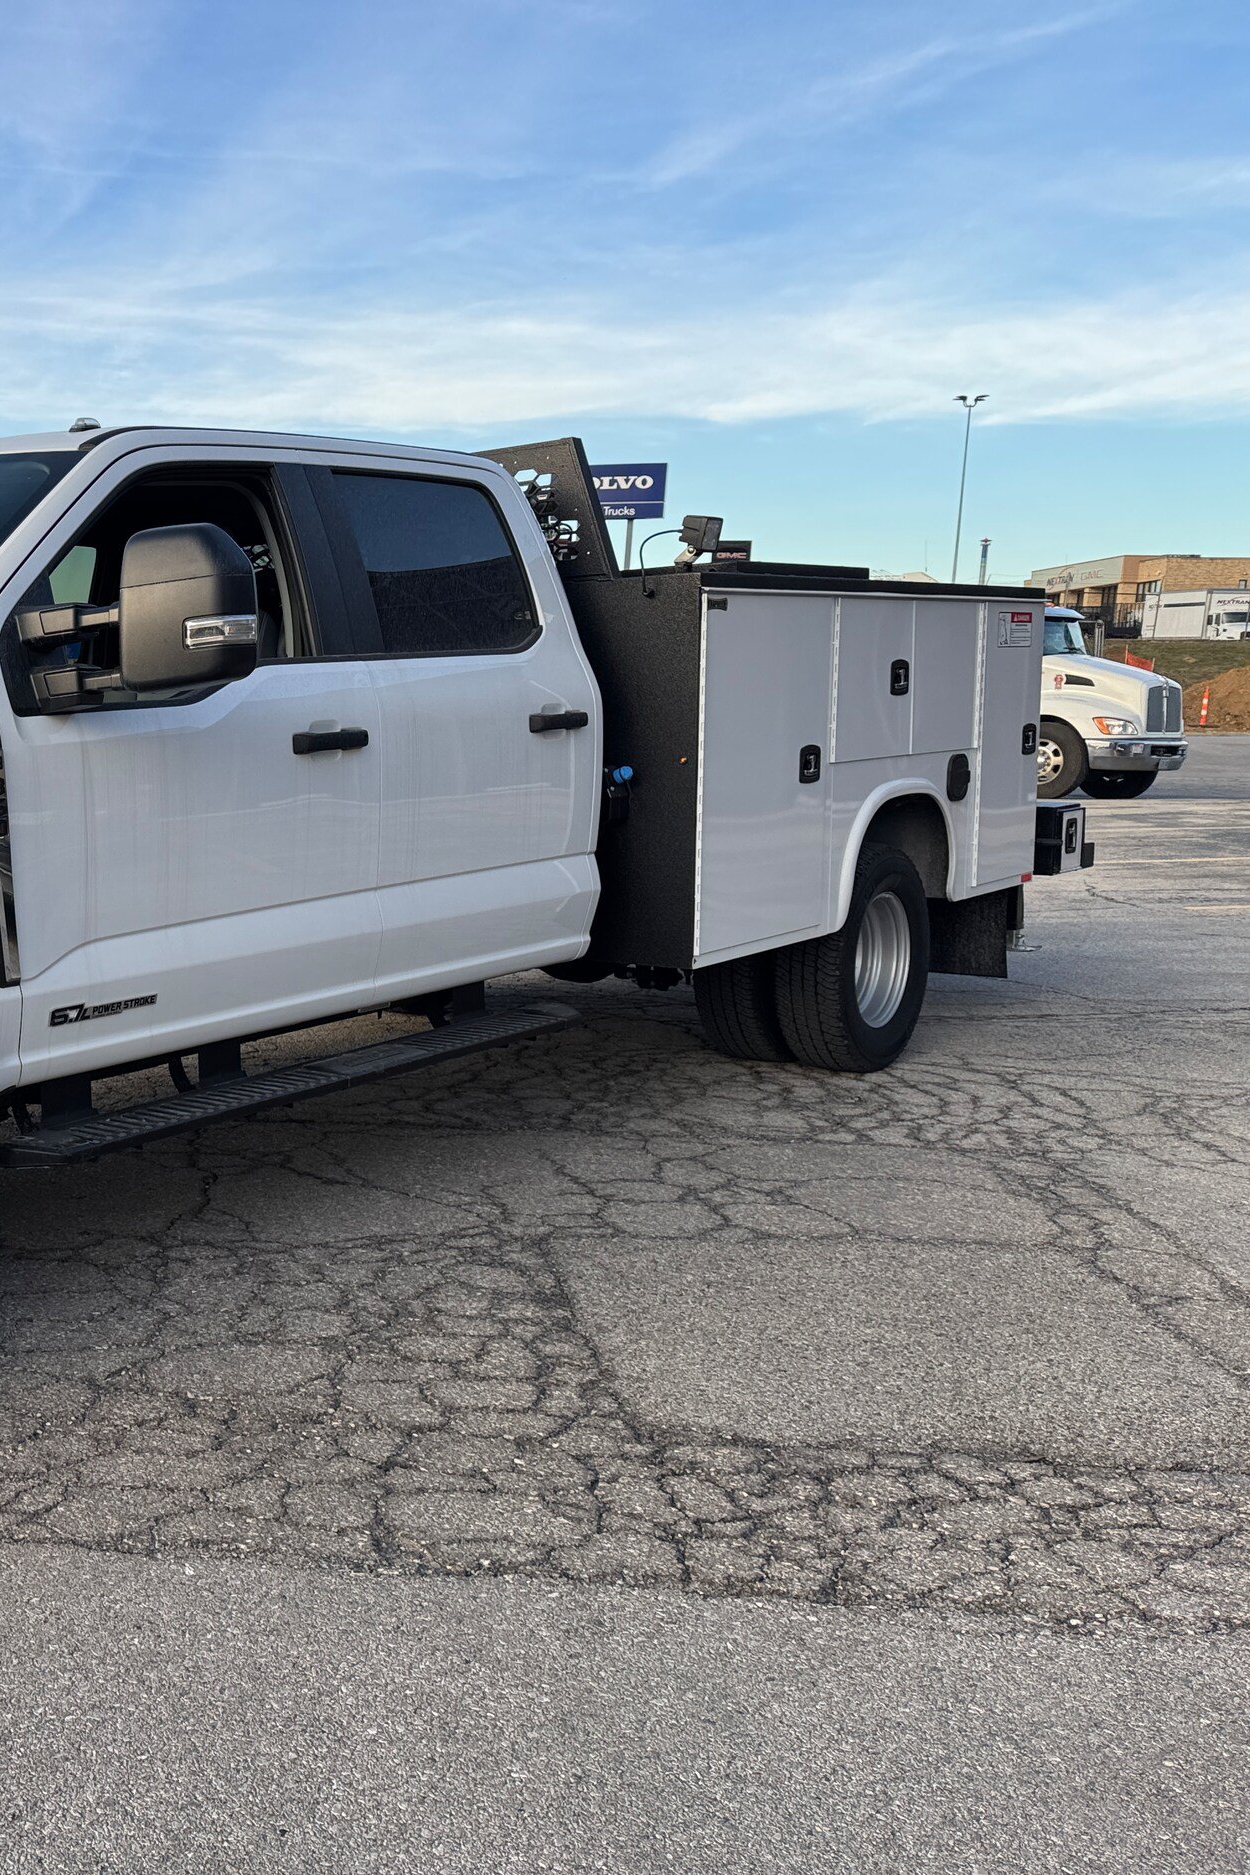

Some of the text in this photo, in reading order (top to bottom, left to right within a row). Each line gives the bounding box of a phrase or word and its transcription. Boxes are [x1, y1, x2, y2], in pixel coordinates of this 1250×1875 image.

[603, 506, 635, 516] Trucks
[92, 1002, 122, 1016] POWER
[123, 995, 156, 1010] STROKE
